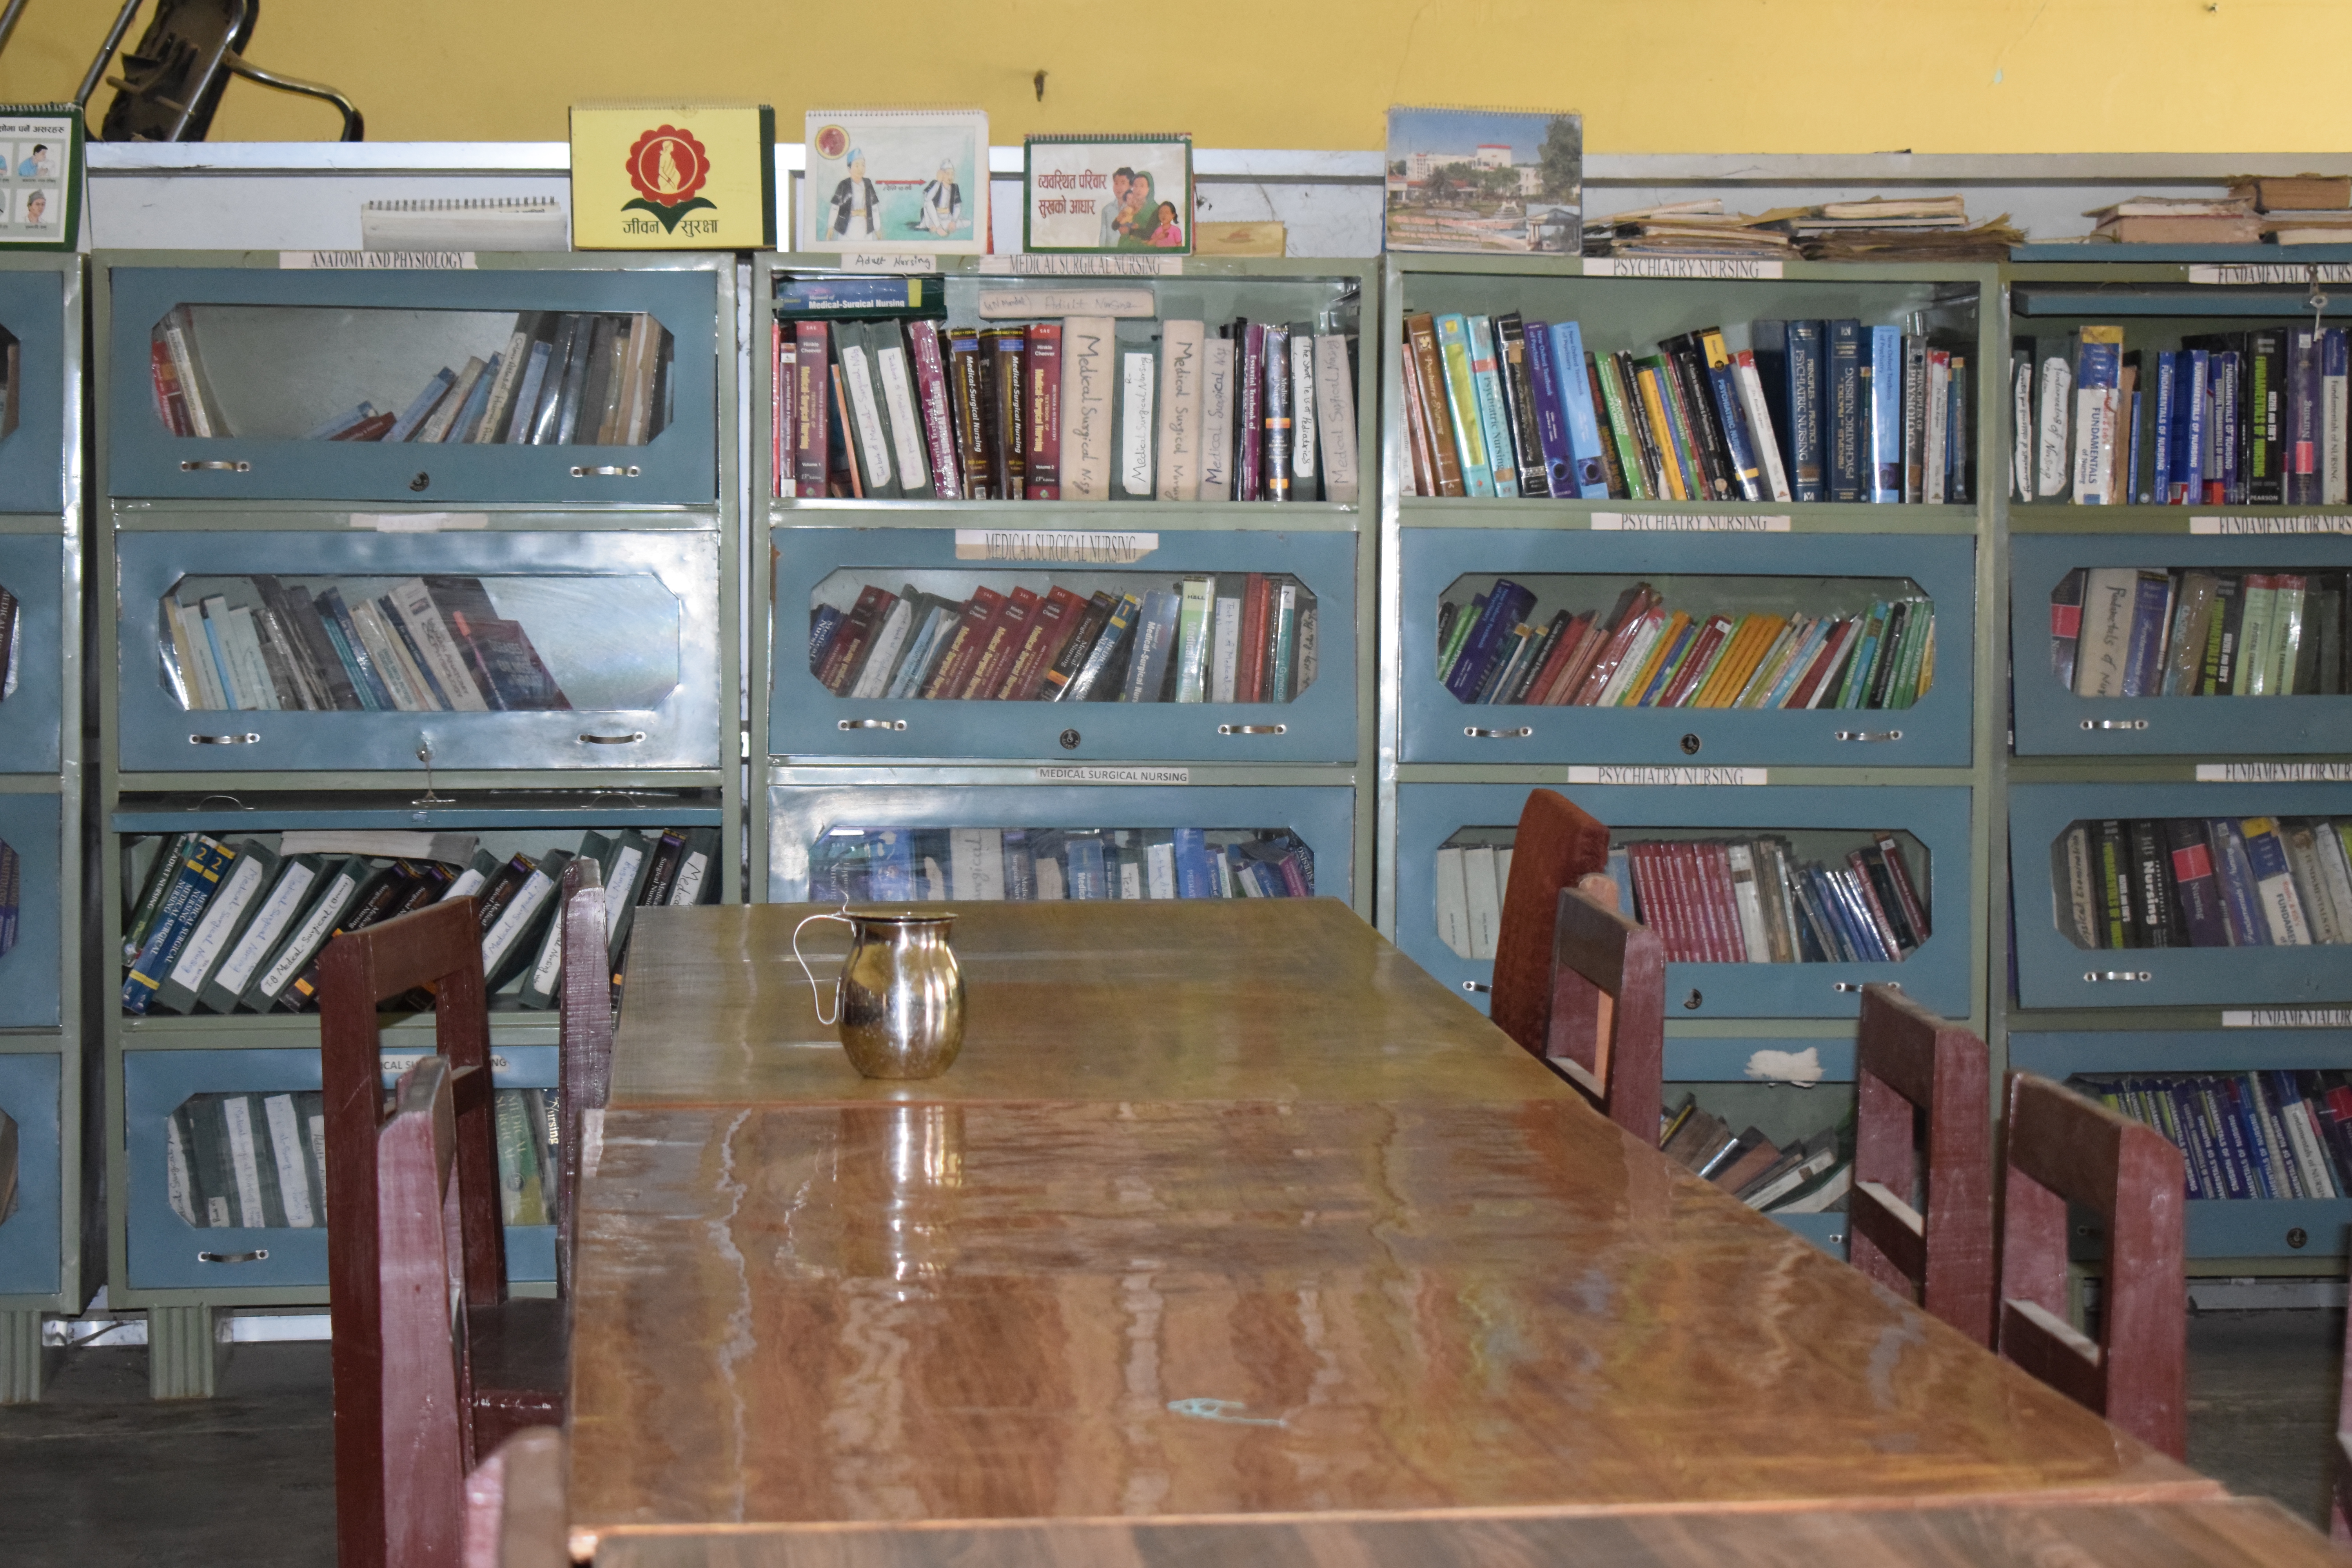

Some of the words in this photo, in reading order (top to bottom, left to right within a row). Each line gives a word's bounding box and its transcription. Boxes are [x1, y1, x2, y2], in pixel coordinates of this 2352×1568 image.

[1038, 170, 1076, 189] व्यवस्थित
[1079, 169, 1107, 189] परिवार
[1038, 196, 1066, 218] सुखको
[1070, 200, 1095, 215] आधार
[622, 218, 659, 234] जीवन
[679, 219, 719, 238] सुरक्षा
[311, 252, 365, 268] ANATOMY
[368, 252, 390, 268] AND
[394, 252, 464, 268] PHYSIOLOGY
[1009, 255, 1057, 274] MEDICAL
[1059, 255, 1111, 274] SURGICAL
[1114, 256, 1161, 275] NURSING
[1613, 259, 1695, 276] PSYCHIATRY
[1700, 260, 1759, 279] NURSING
[809, 299, 874, 309] Medical-Surgical
[875, 299, 905, 308] Nursing
[1302, 344, 1311, 358] The
[1539, 345, 1548, 367] Oxford
[1073, 334, 1105, 403] Medical
[1134, 356, 1152, 390] Nursing
[1172, 341, 1192, 397] Medical
[1543, 368, 1553, 396] Textbook
[1795, 350, 1807, 412] PSYCHIATRIC
[965, 355, 979, 421] Medical-Surgical
[972, 422, 982, 452] Nursing
[1207, 370, 1229, 419] Surgical
[1717, 379, 1736, 429] PSYCHIATRIC
[1844, 367, 1855, 414] NURSING
[2158, 364, 2168, 424] FUNDAMENTALS
[2192, 362, 2201, 421] FUNDAMENTALS
[2330, 380, 2339, 431] Fundamentals
[1132, 392, 1150, 431] Surgical
[1481, 376, 1499, 430] Psychiatric
[1491, 431, 1506, 470] Nursing
[1907, 369, 1916, 449] PHYSIOLOGY
[1033, 425, 1044, 452] Nursing
[1071, 405, 1101, 461] Surgical
[1167, 406, 1191, 455] Surgical
[1797, 414, 1808, 461] NURSING
[2158, 425, 2165, 435] OF
[2191, 423, 2199, 432] OF
[2225, 425, 2232, 435] OF
[1131, 432, 1150, 482] Medical
[1204, 424, 1225, 485] Medical
[1329, 429, 1349, 484] Medical
[1843, 416, 1856, 478] PSYCHIATRIC
[2088, 408, 2100, 483] FUNDAMENTALS
[2156, 437, 2165, 470] NURSING
[2190, 434, 2198, 468] NURSING
[2078, 457, 2087, 484] Nursing
[2330, 444, 2338, 482] NURSING
[1621, 514, 1703, 530] PSYCHIATRY
[1707, 515, 1767, 531] NURSING
[985, 533, 1033, 560] MEDICAL
[1035, 534, 1086, 562] SURGICAL
[1090, 535, 1136, 563] NURSING
[1122, 605, 1129, 617] 1
[1074, 616, 1092, 642] Surgical
[1184, 621, 1198, 658] Medical
[1059, 641, 1078, 668] Nursing
[1134, 620, 1156, 685] Medical-Surgical
[1040, 768, 1085, 779] MEDICAL
[1088, 770, 1138, 780] SURGICAL
[1141, 771, 1187, 782] NURSING
[1598, 767, 1679, 784] PSYCHIATRY
[1682, 768, 1744, 785] NURSING
[160, 852, 180, 878] ADULT
[196, 847, 205, 860] 2
[212, 858, 222, 870] 2
[651, 856, 668, 884] Surgical
[144, 877, 169, 911] NURSING
[487, 877, 509, 904] Surgical
[611, 860, 636, 895] Nursing
[2141, 861, 2160, 925] Nursing
[162, 878, 187, 914] NURSING
[169, 882, 193, 918] MEDICAL
[177, 888, 201, 923] NURSING
[183, 892, 208, 927] MEDICAL
[367, 881, 389, 909] Surgical
[348, 902, 370, 932] Nursing
[148, 917, 175, 956] SURGICAL
[163, 926, 189, 965] SURGICAL
[180, 943, 207, 976] Nursing
[537, 945, 558, 975] Nursing
[501, 1093, 532, 1152] MEDICAL
[544, 1096, 563, 1144] Nursing
